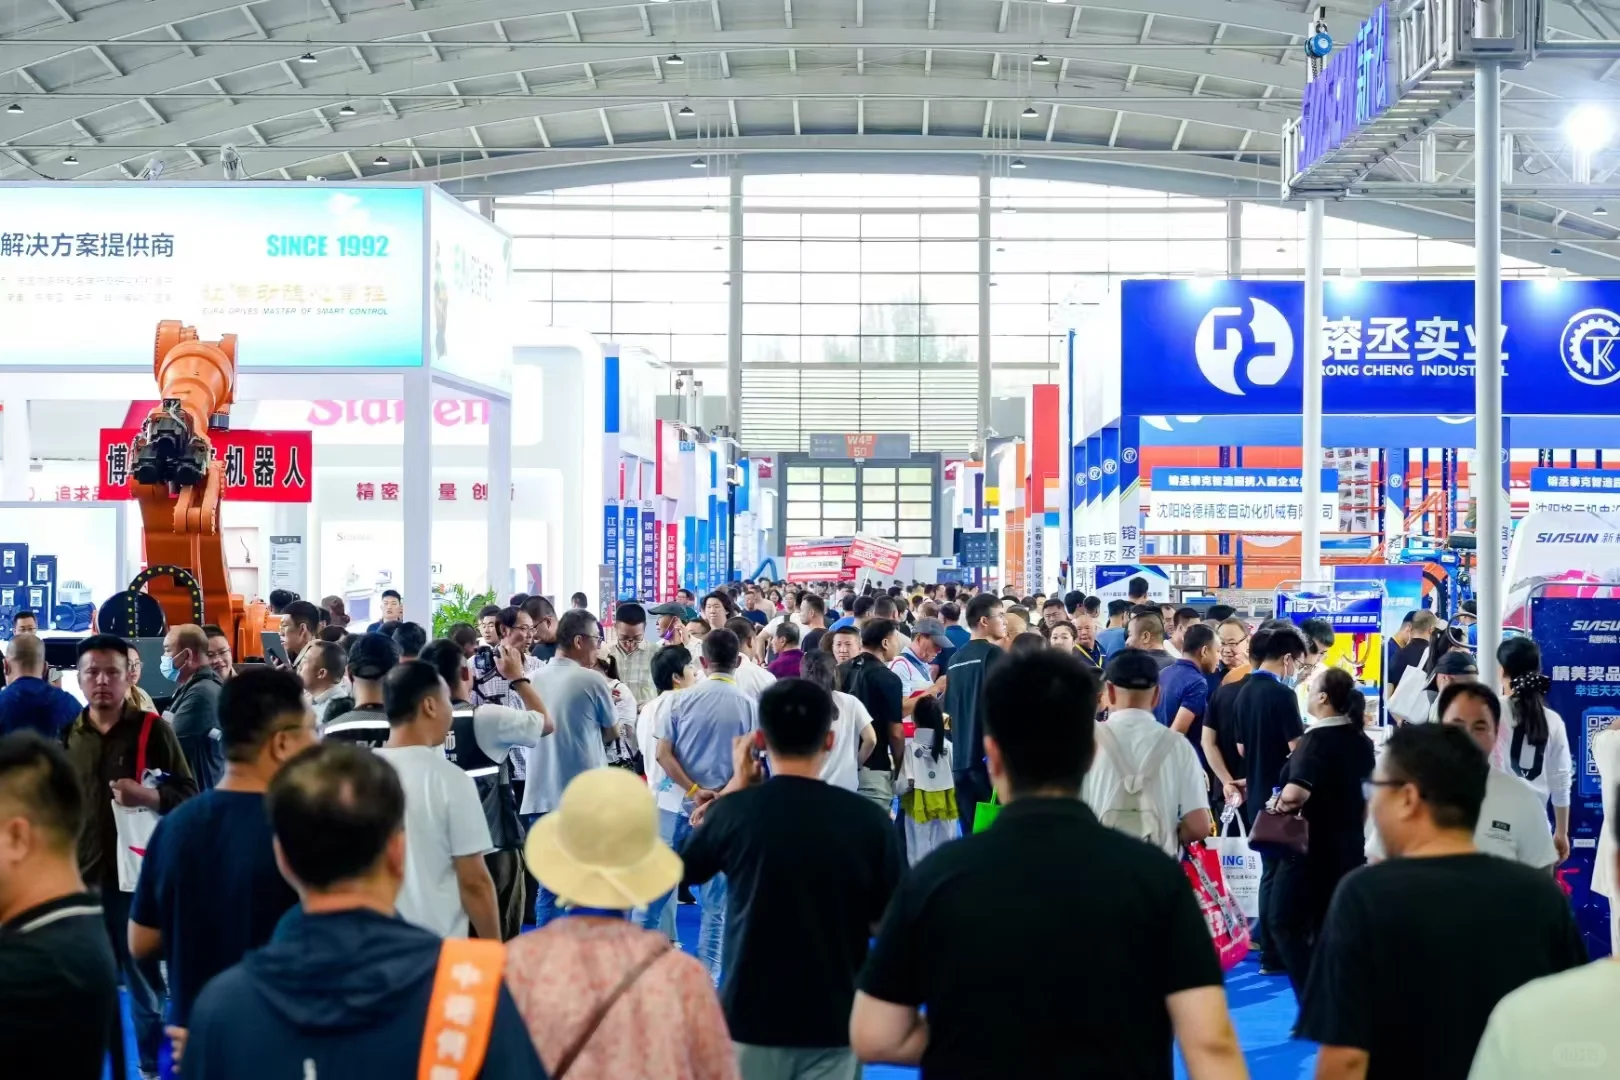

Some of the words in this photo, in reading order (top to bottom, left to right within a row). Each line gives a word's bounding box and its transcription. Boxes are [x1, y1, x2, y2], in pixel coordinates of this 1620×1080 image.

[0, 232, 175, 258] 解决方案提供商
[267, 234, 328, 257] SINCE
[336, 235, 390, 257] 1992
[263, 308, 297, 316] MASTER
[300, 308, 313, 316] OF
[316, 308, 345, 316] SMART
[349, 308, 389, 316] CONTROL
[1362, 365, 1414, 376] CHENG
[1535, 533, 1599, 543] SIASUN
[1552, 665, 1620, 681] 精美奖品
